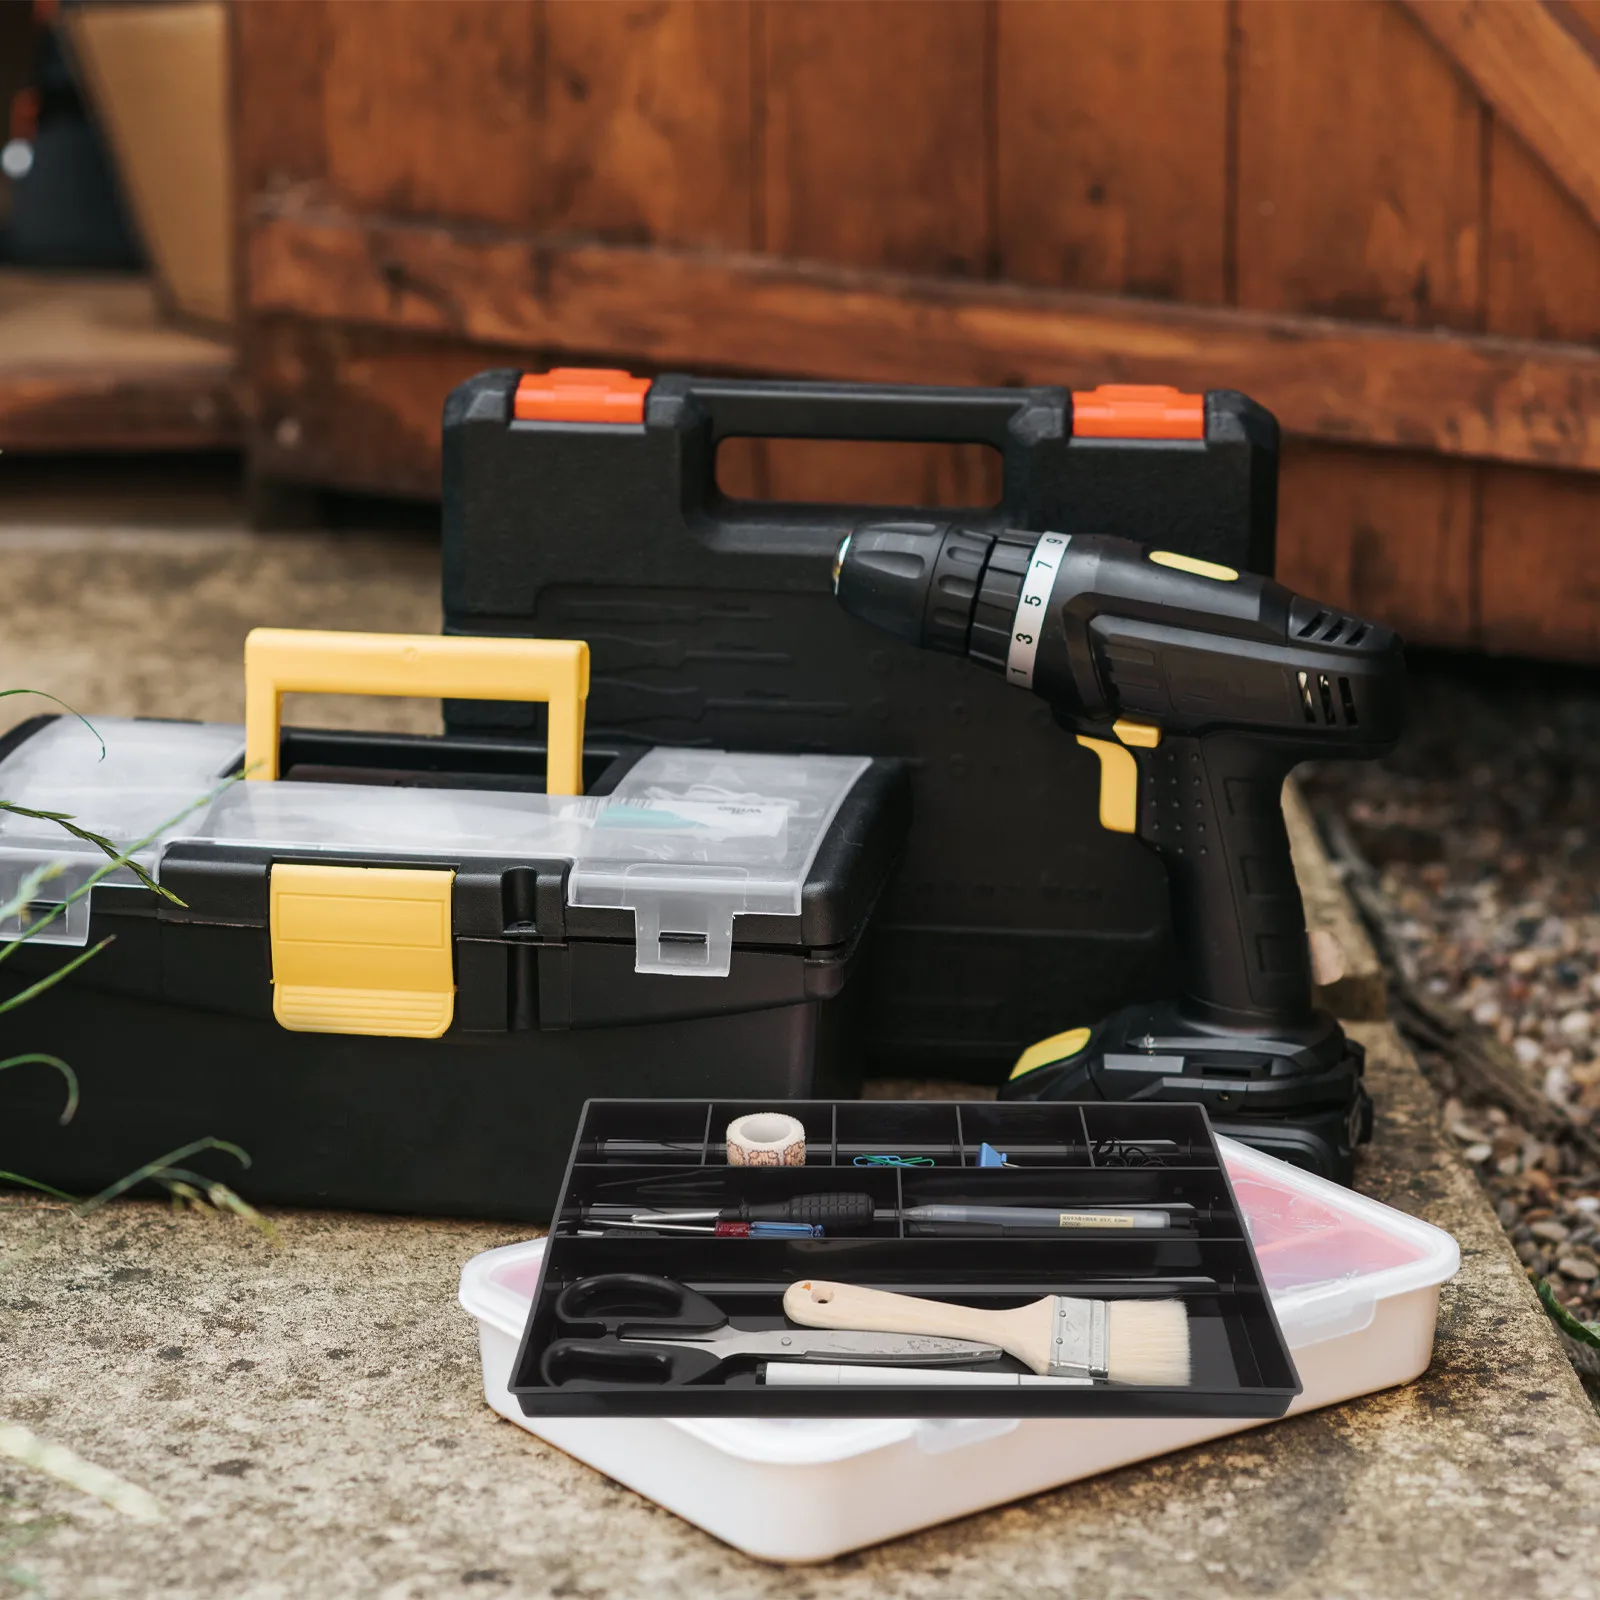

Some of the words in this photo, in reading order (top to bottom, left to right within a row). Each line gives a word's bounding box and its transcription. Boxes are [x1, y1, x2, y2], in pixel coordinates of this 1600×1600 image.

[1046, 537, 1063, 545] 9
[1035, 560, 1053, 569] 7
[1024, 594, 1041, 607] 5
[1015, 632, 1033, 645] 3
[1010, 667, 1027, 675] 1
